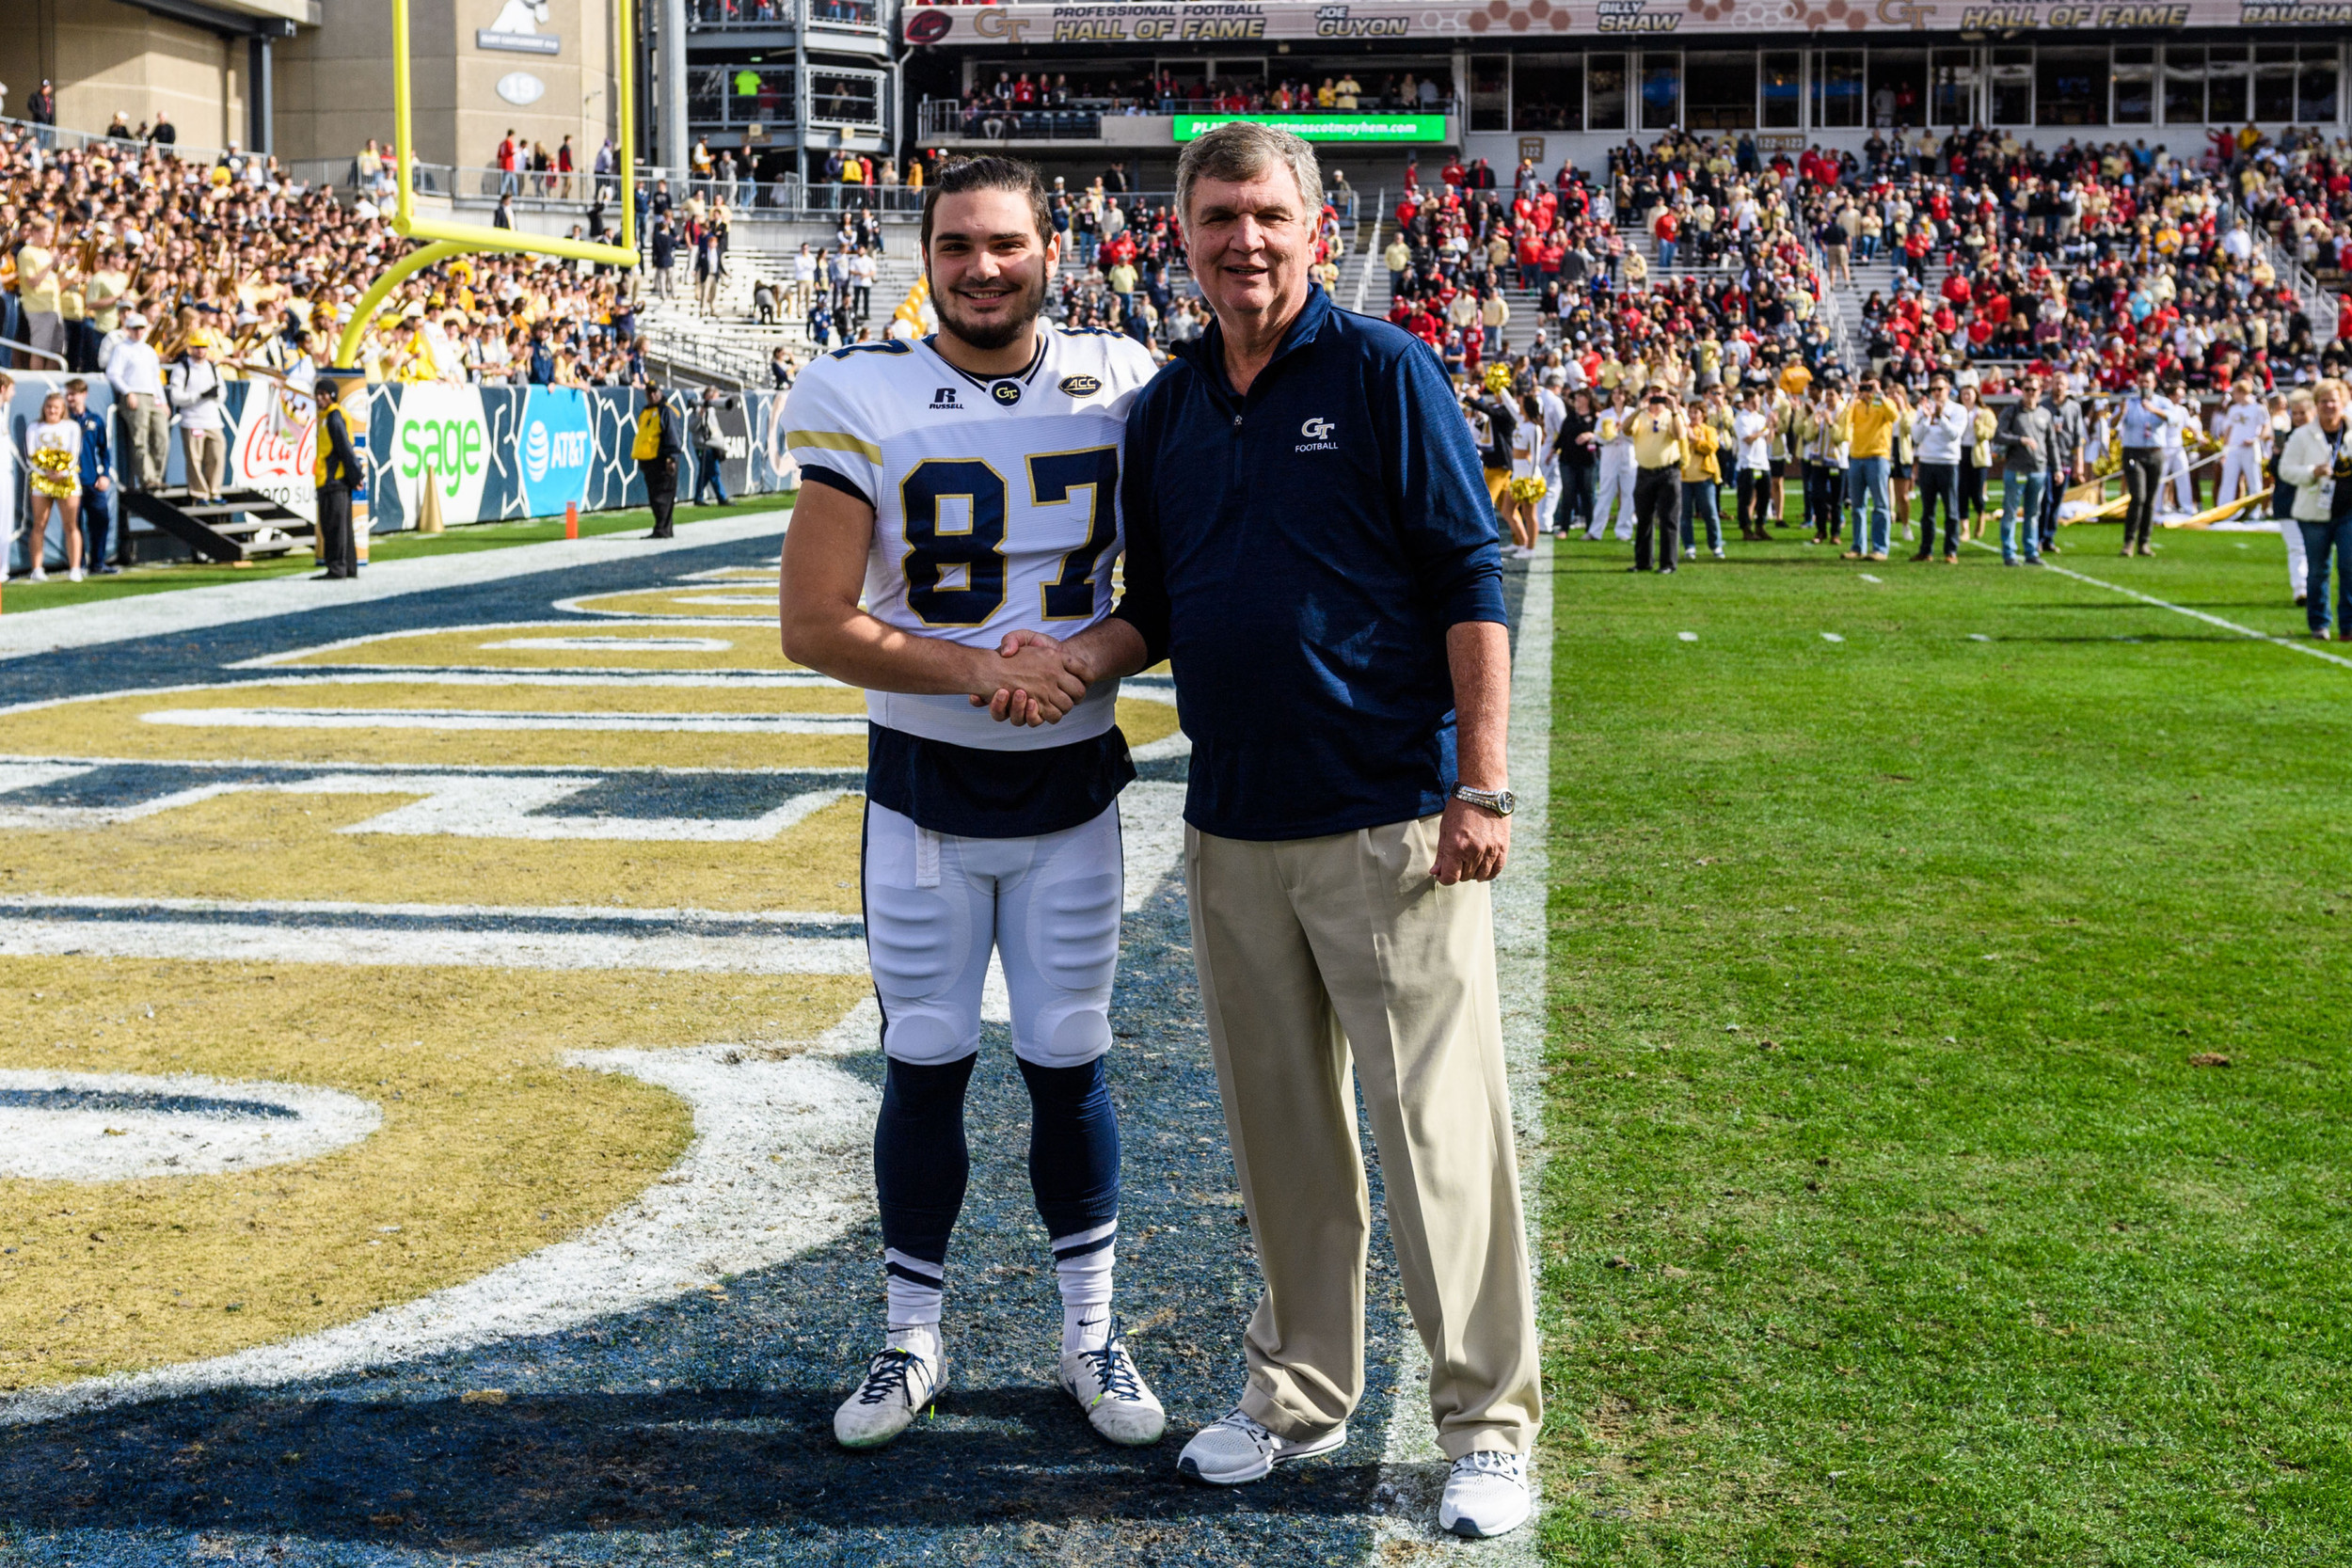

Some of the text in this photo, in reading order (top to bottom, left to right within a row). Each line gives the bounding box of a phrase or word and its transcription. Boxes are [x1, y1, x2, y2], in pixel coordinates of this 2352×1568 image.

[1053, 4, 1263, 17] PROFESSIONAL FOOTBALL
[1316, 7, 1348, 19] JOE
[1597, 1, 1647, 14] BILLY
[1961, 4, 2191, 29] HALL OF FAME
[1053, 17, 1266, 40] HALL OF FAME
[1316, 17, 1410, 37] GUYON
[1598, 13, 1681, 33] SHAW
[1066, 378, 1096, 388] ACC
[1301, 417, 1335, 439] GT
[551, 431, 588, 469] AT&T
[1295, 442, 1339, 452] FOOTBALL
[402, 420, 482, 498] sage
[899, 444, 1120, 628] 87
